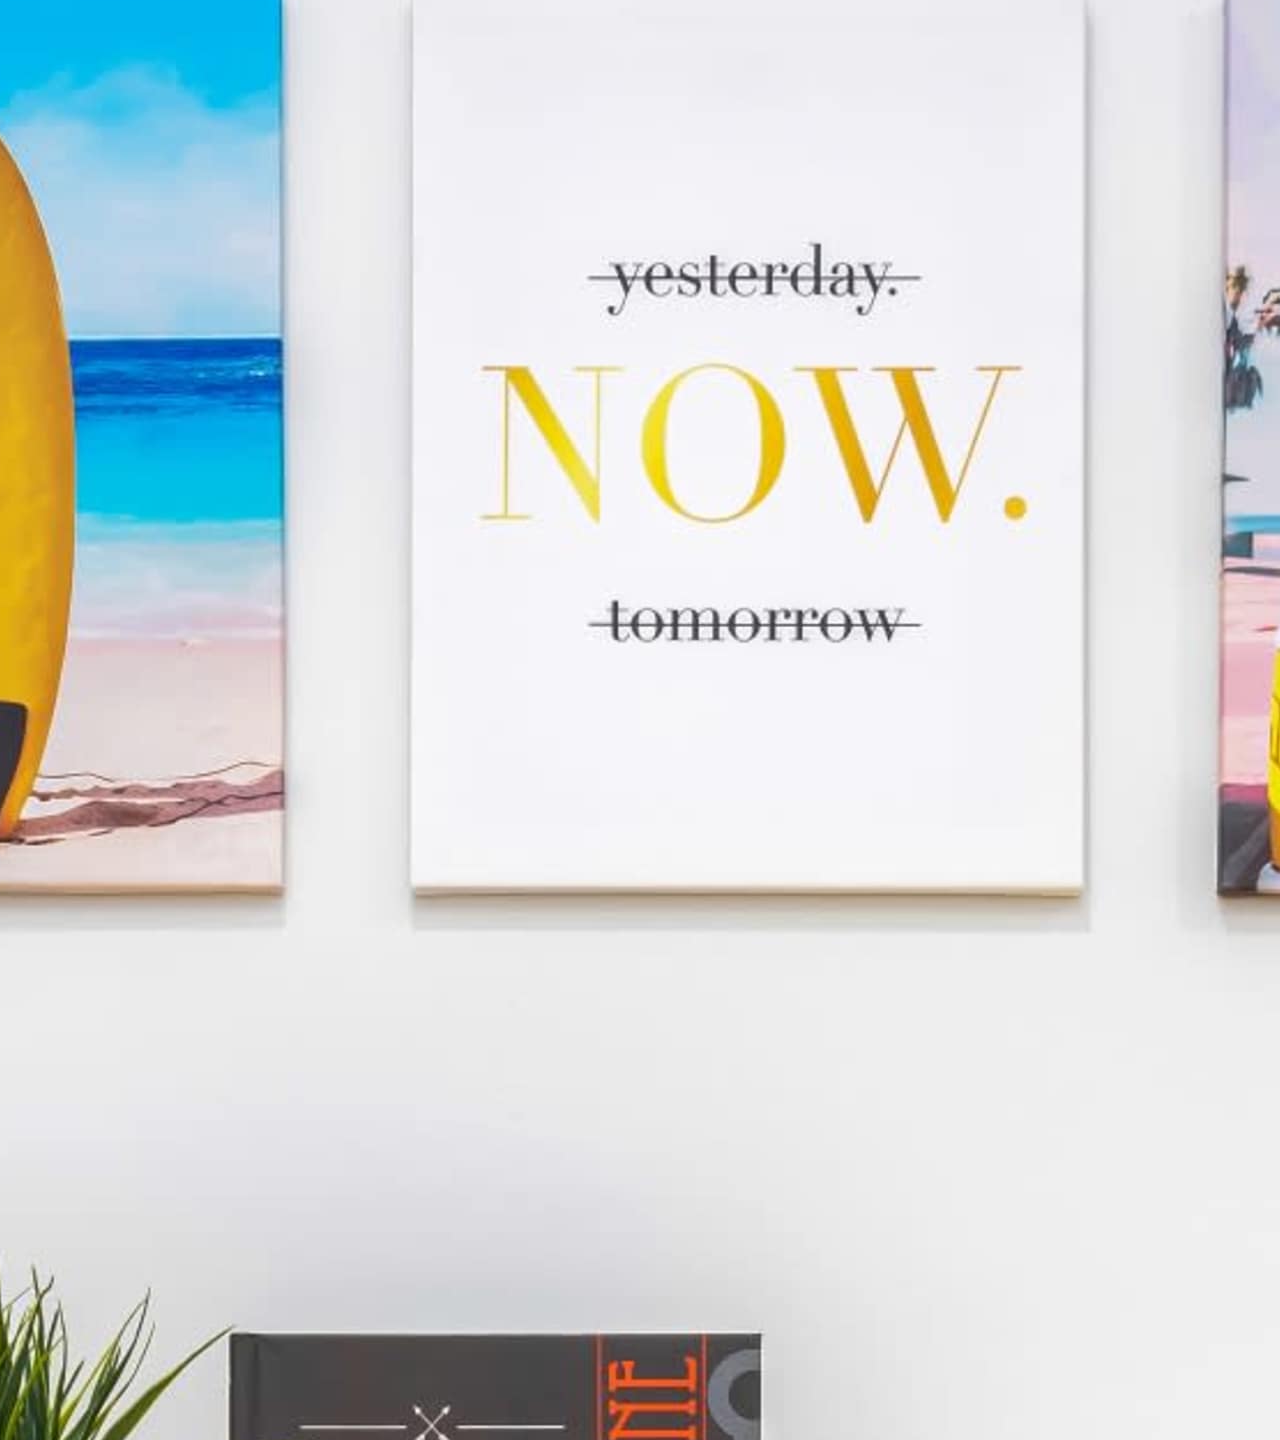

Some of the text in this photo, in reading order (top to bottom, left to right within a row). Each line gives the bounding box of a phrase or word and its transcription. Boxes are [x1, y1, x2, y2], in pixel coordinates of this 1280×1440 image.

[607, 242, 899, 316] yesterday.
[480, 363, 1027, 525] NOW.
[606, 599, 906, 643] tomorrow
